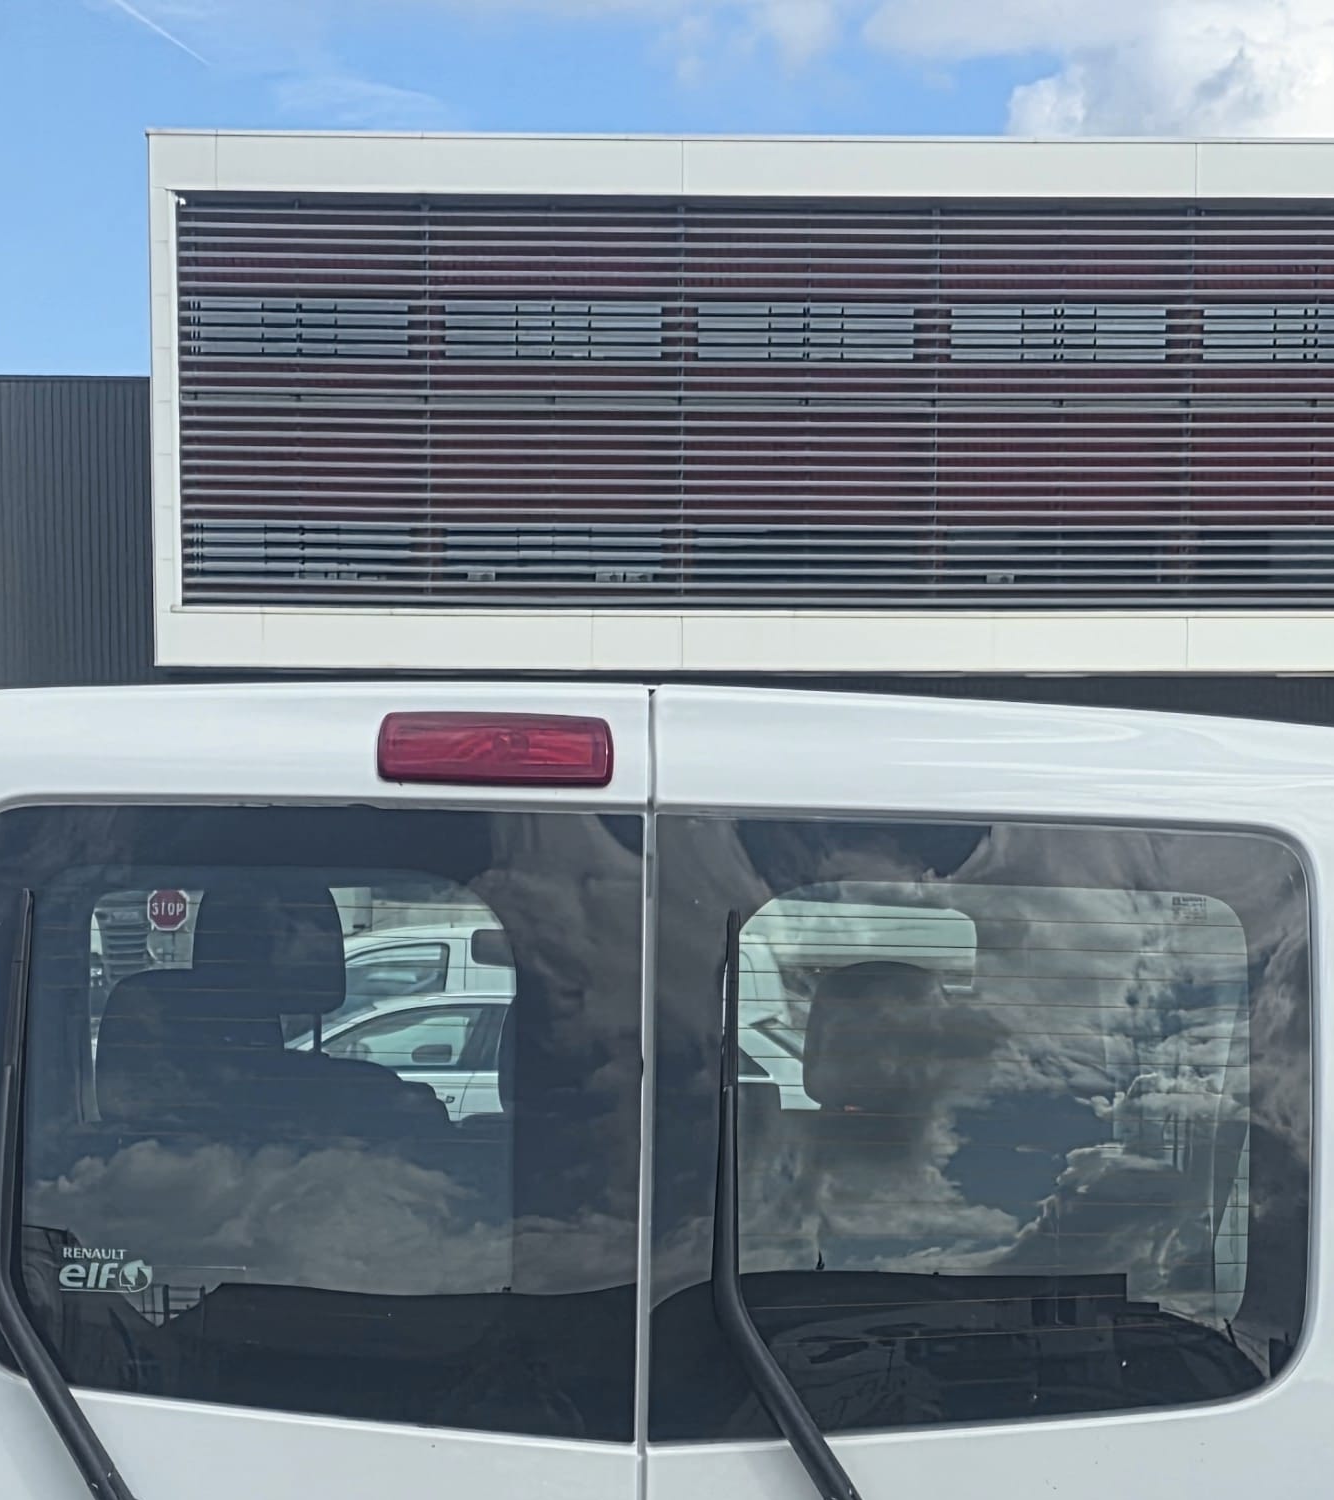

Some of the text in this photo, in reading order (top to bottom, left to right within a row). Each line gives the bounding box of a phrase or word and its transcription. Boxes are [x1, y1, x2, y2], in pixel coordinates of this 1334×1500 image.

[151, 902, 185, 916] STOP
[62, 1247, 128, 1260] RENAULT
[58, 1262, 119, 1289] elf
